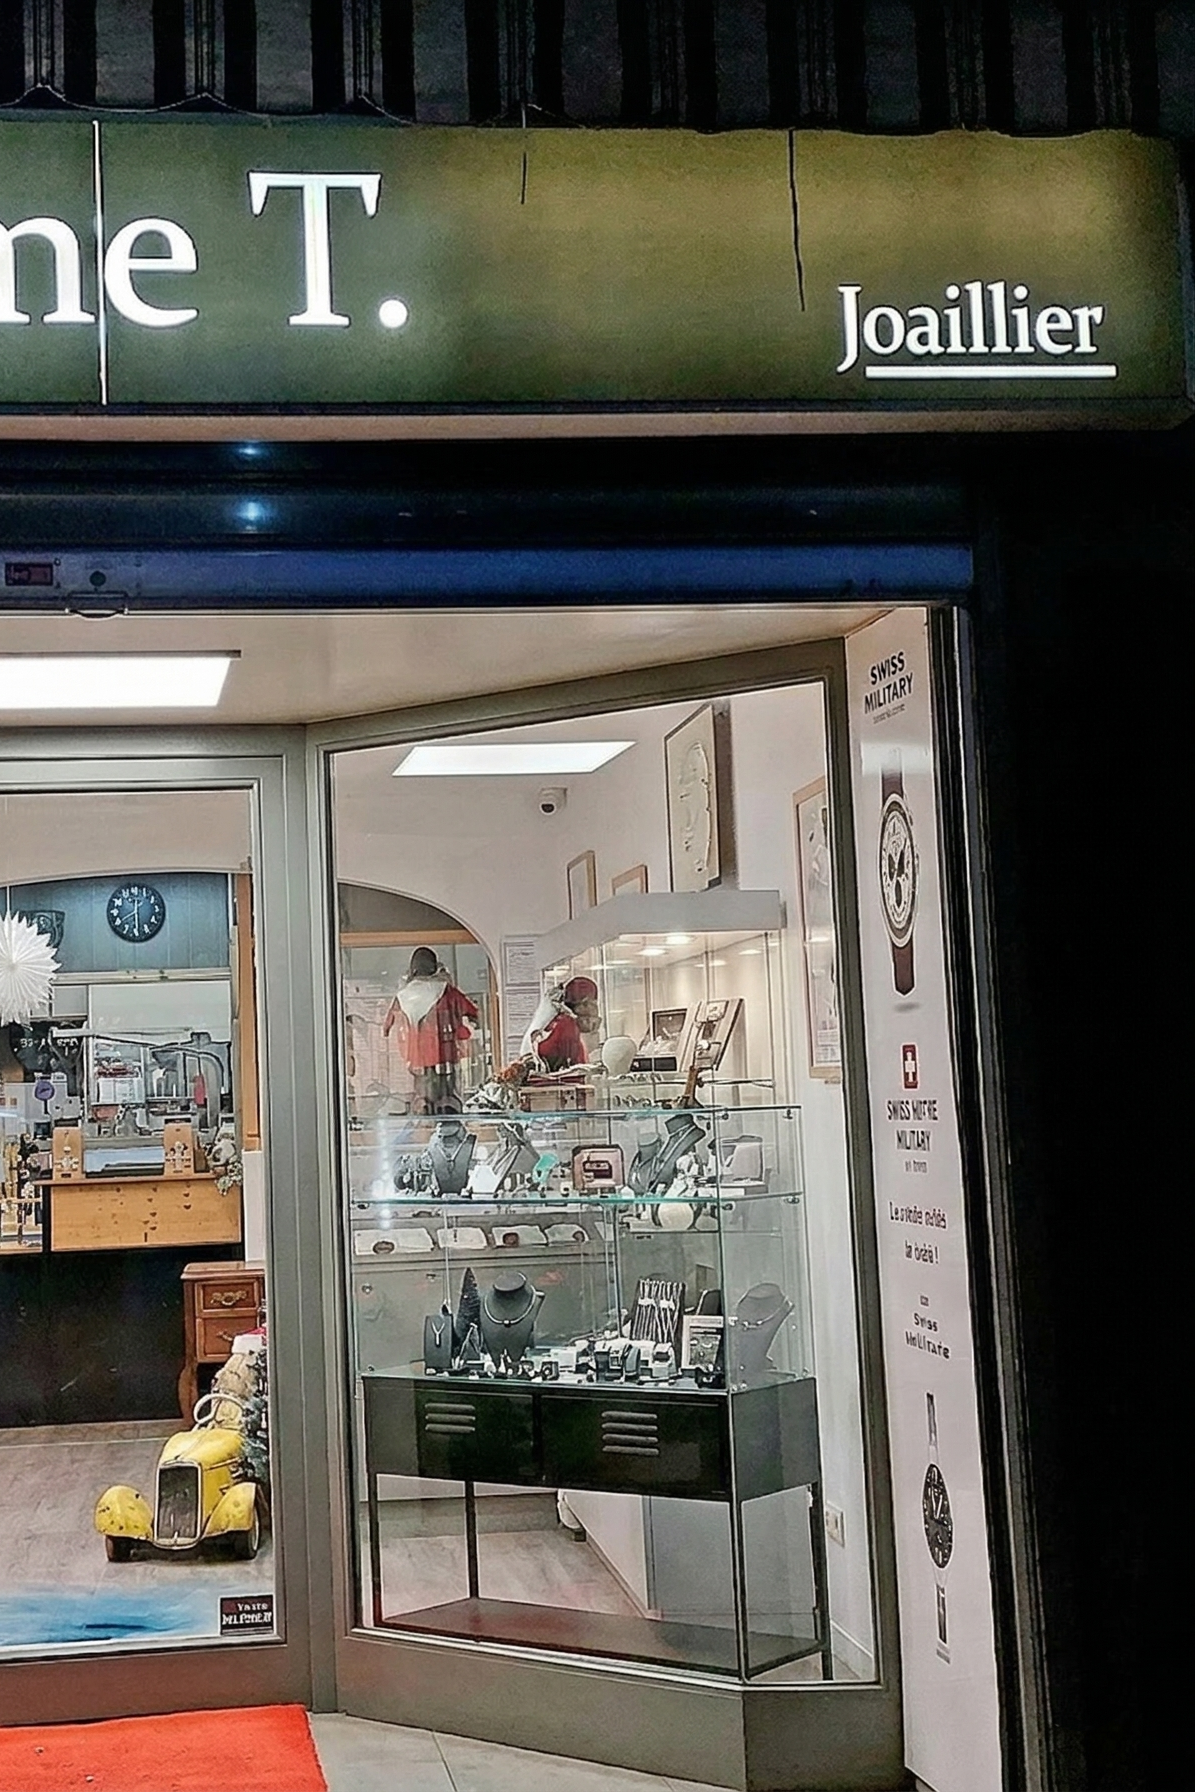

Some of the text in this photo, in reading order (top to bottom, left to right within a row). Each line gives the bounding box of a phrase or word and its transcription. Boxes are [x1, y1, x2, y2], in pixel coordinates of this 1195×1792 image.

[248, 170, 407, 329] T.
[836, 279, 1105, 374] Joaillier
[864, 672, 914, 714] MILITARY
[870, 651, 905, 685] SWISS
